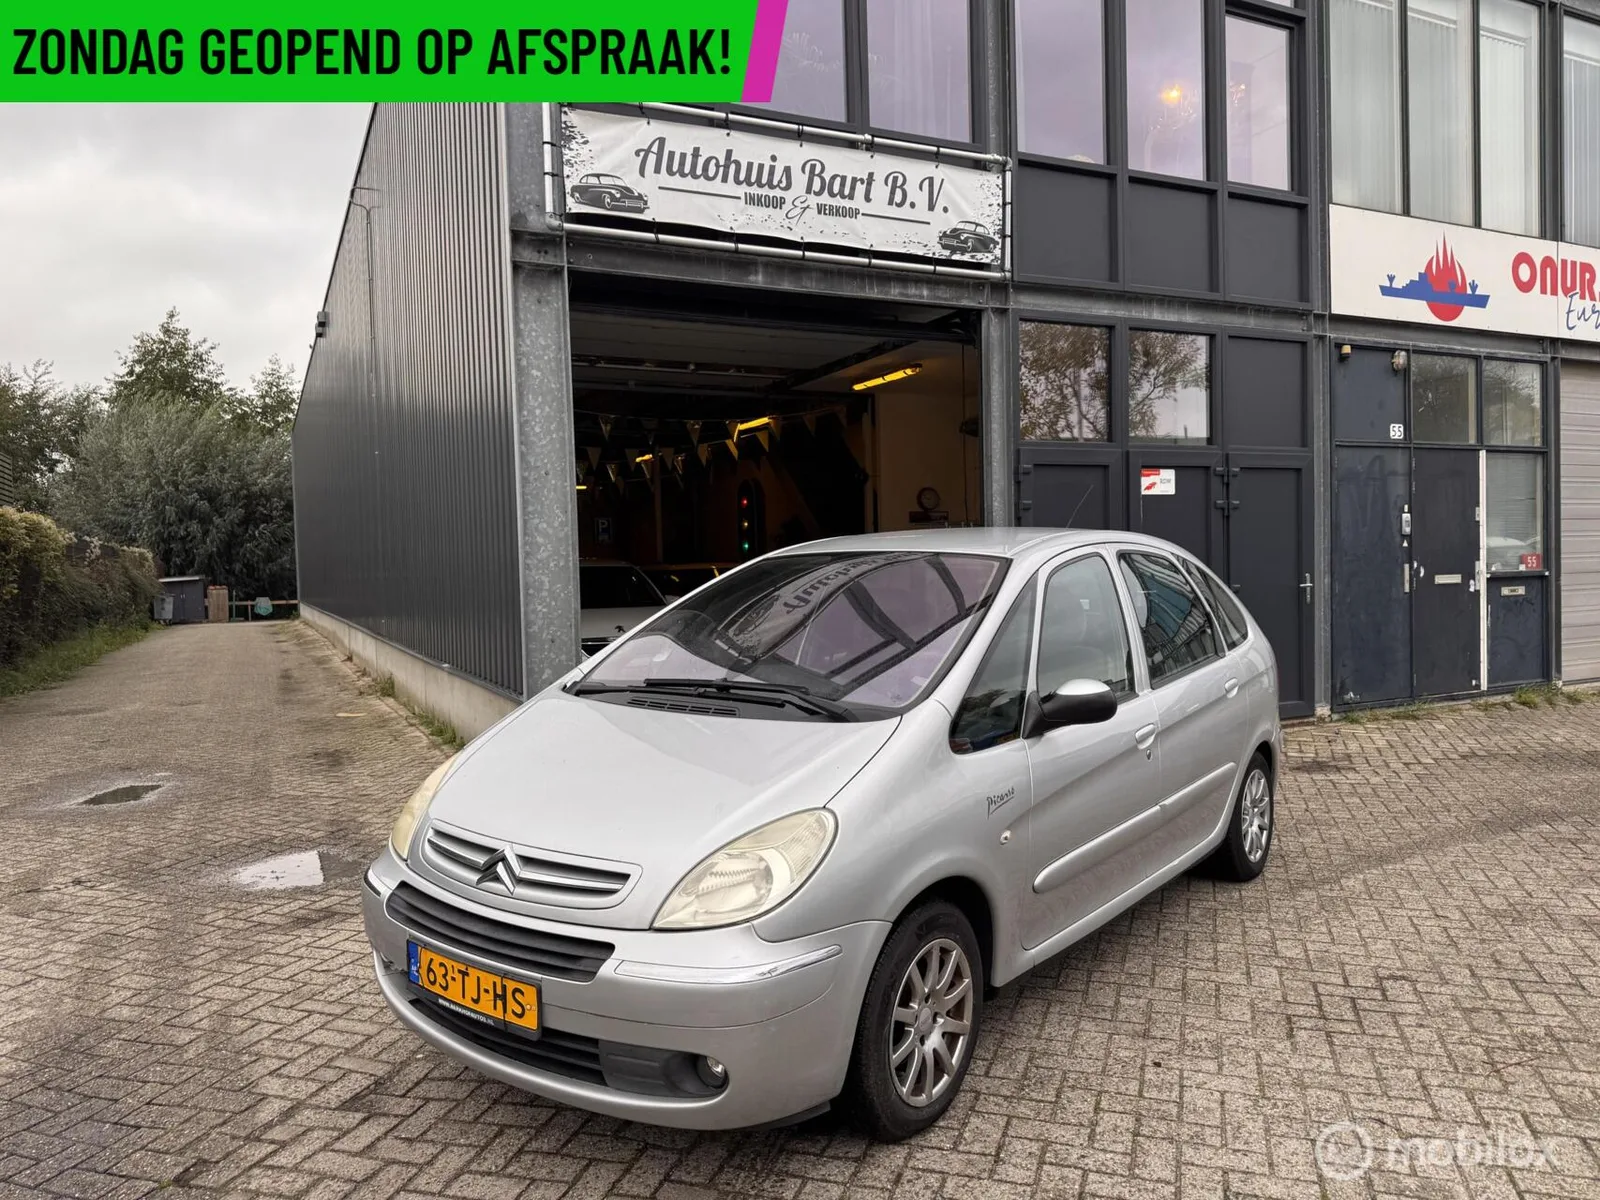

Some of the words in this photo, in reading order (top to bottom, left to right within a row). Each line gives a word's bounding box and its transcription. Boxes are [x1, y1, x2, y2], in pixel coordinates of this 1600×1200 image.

[634, 136, 793, 192] Autohuis
[801, 158, 876, 204] Bart
[884, 170, 949, 214] B.V.
[743, 191, 787, 210] INKOOP
[816, 202, 861, 220] VERKOOP
[1511, 251, 1600, 303] ONUR
[1391, 425, 1403, 438] 55
[1527, 556, 1537, 568] 55
[426, 957, 526, 1019] 63-TJ-HS
